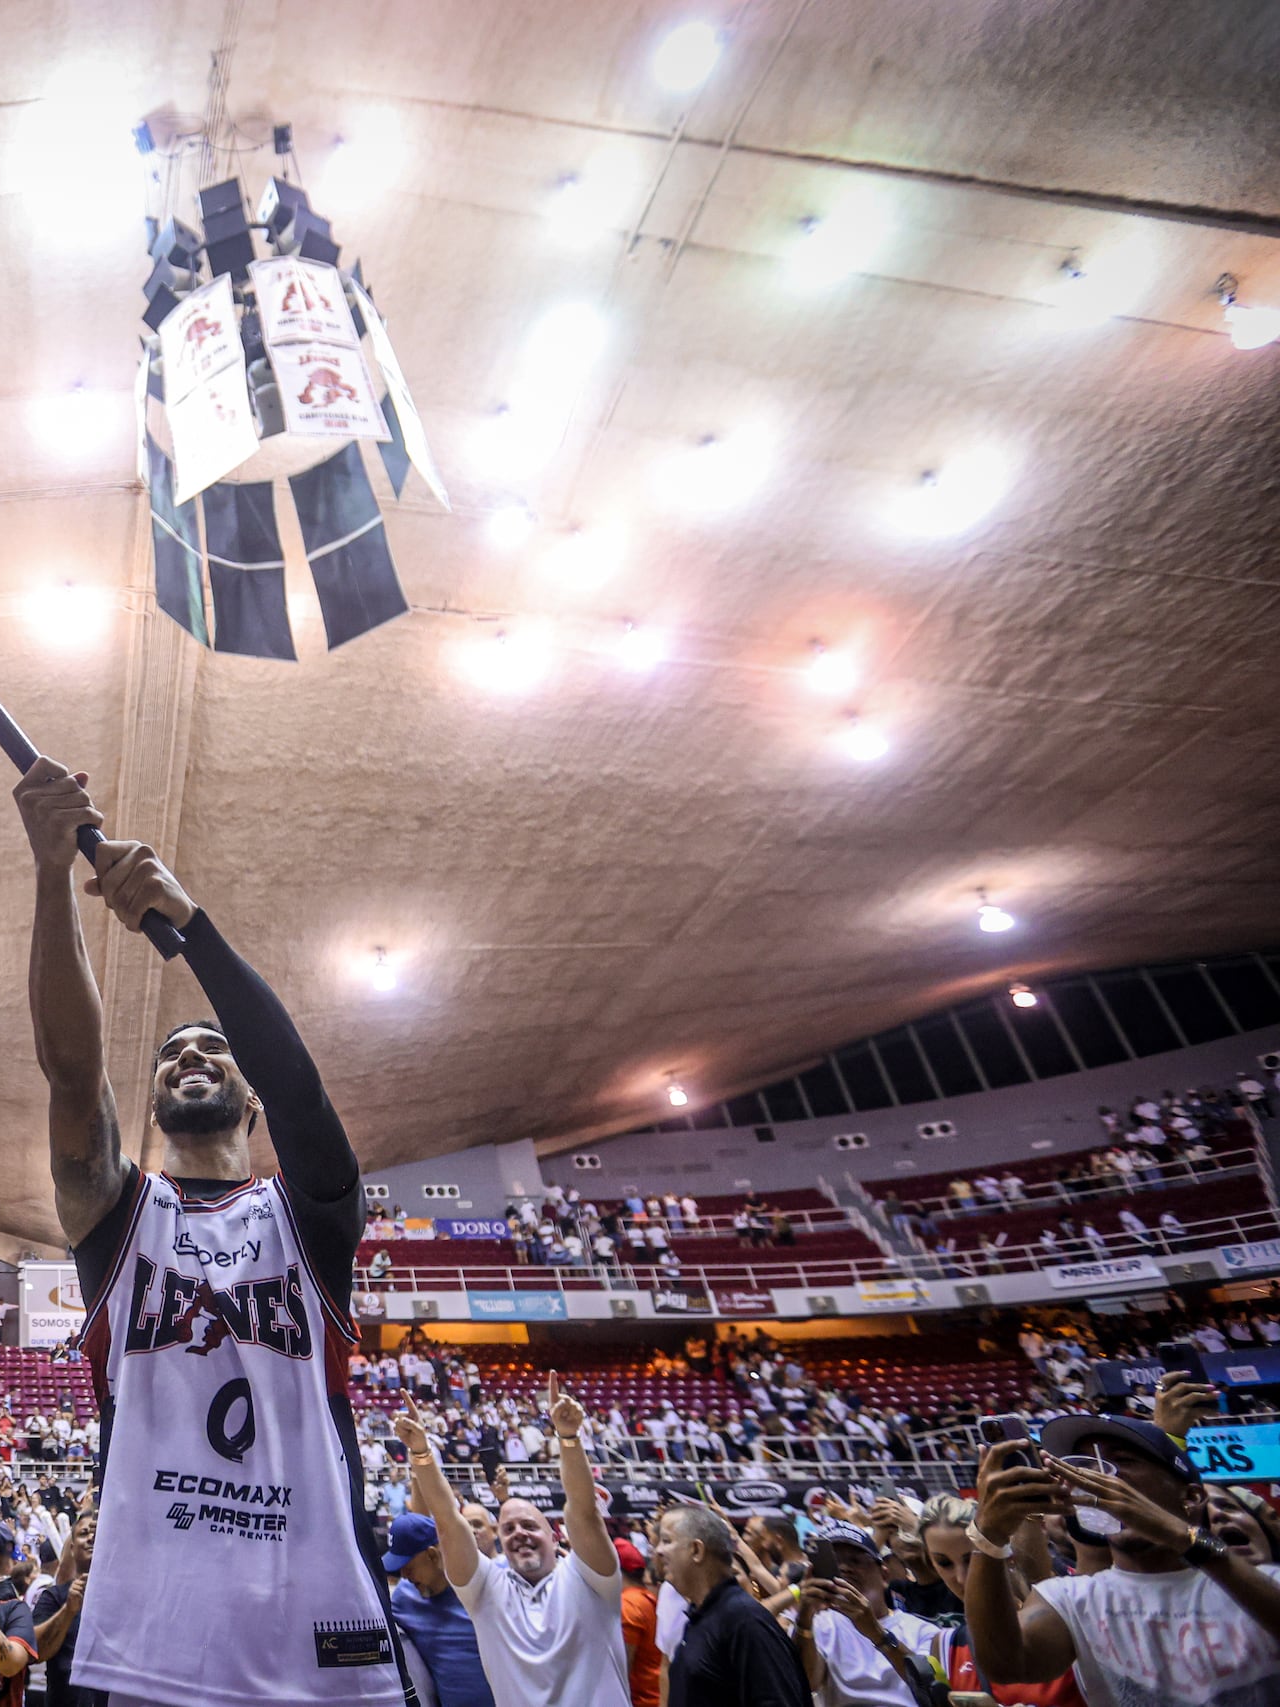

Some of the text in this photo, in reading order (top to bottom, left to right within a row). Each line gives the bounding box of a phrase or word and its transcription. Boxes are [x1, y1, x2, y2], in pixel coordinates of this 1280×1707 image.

[452, 1222, 506, 1237] DON Q
[31, 1318, 83, 1328] SOMOS E
[207, 1378, 255, 1463] 0
[153, 1470, 292, 1508] ECOMAXX
[199, 1504, 287, 1532] MASTER
[210, 1524, 283, 1541] CAR RENTAL
[379, 1639, 390, 1652] M
